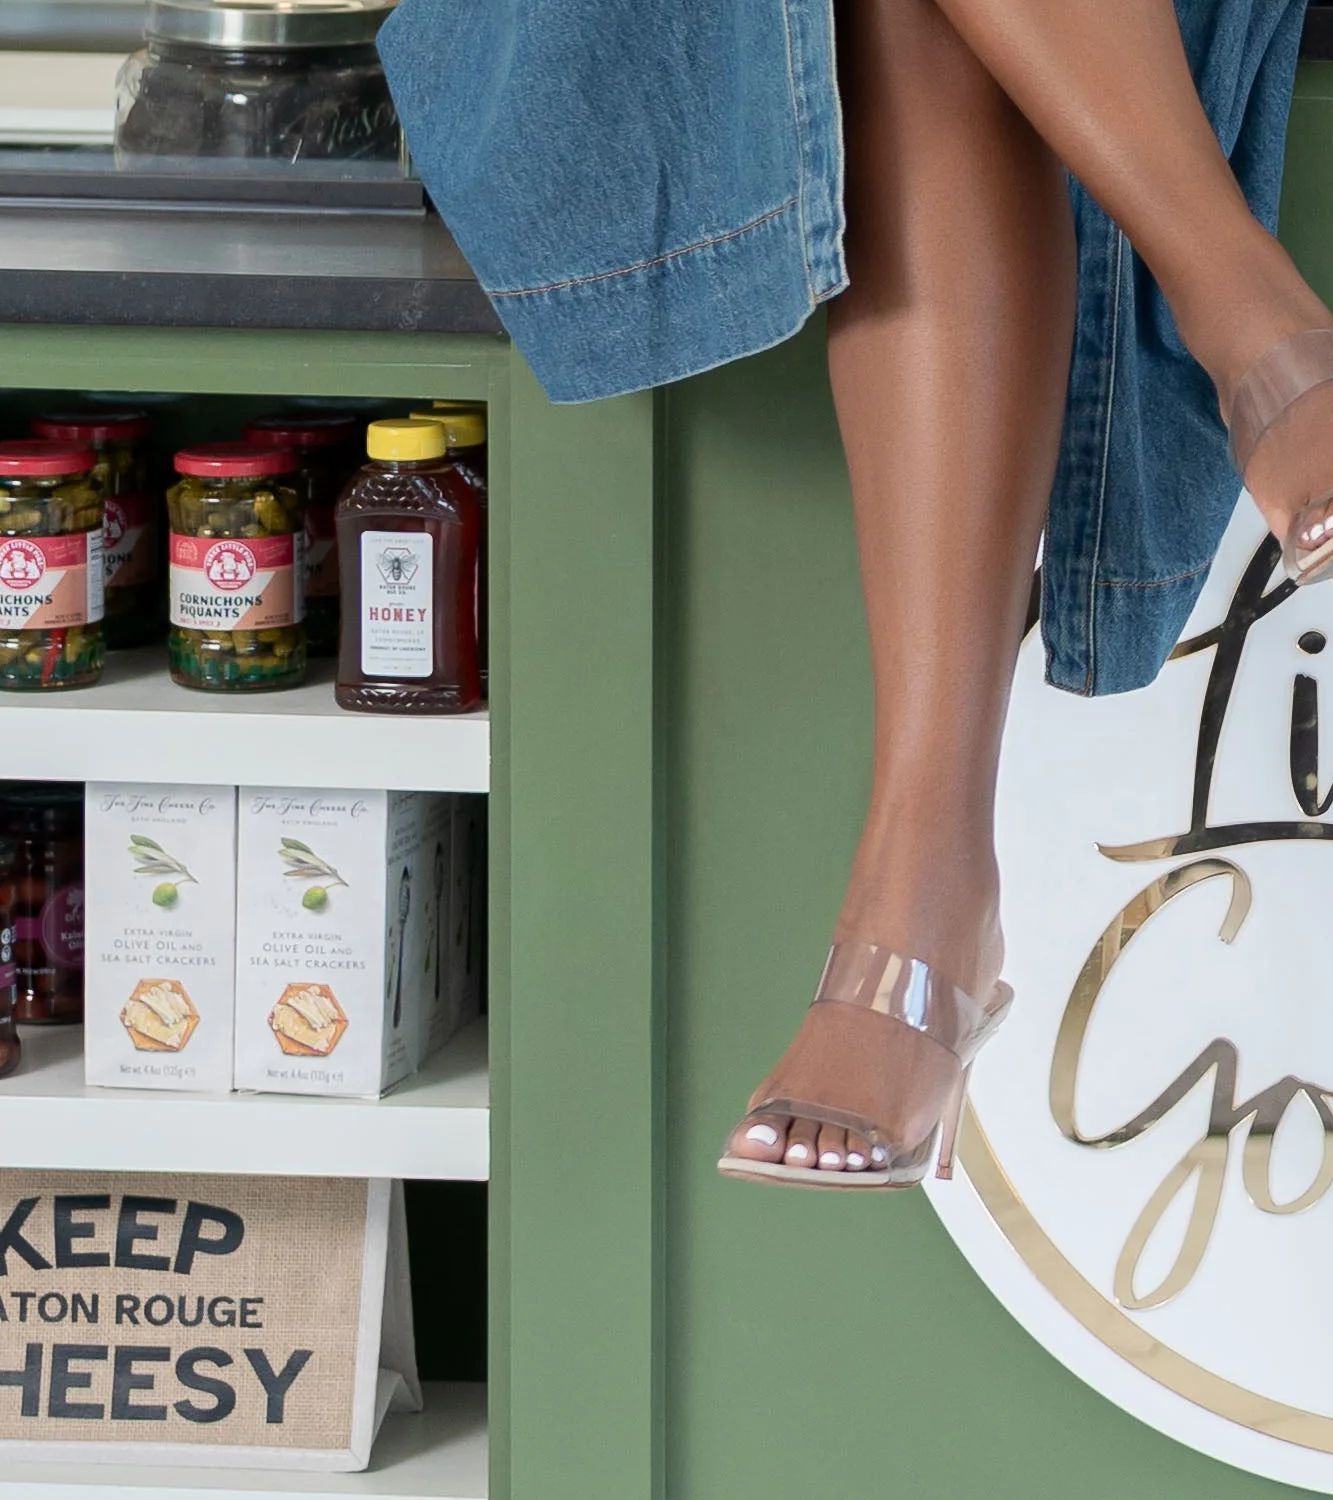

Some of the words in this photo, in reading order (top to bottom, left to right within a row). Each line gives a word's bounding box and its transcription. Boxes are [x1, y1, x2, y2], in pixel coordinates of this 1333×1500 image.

[180, 593, 263, 607] CORNICHONS
[180, 604, 240, 618] PIQUANTS
[369, 606, 428, 623] HONEY
[124, 928, 154, 936] EXTRA
[159, 929, 193, 938] VIRGIN
[272, 931, 304, 940] EXTRA
[307, 932, 343, 941] VIRGIN
[113, 939, 149, 950] OLIVE
[156, 940, 177, 951] OIL
[181, 943, 204, 952] AND
[262, 942, 300, 954] OLIVE
[304, 944, 326, 955] OIL
[330, 947, 353, 956] AND
[100, 953, 121, 963] SEA
[125, 954, 152, 964] SALT
[156, 955, 217, 967] CRACKERS
[250, 956, 270, 966] SEA
[273, 958, 300, 968] SALT
[305, 959, 367, 970] CRACKERS
[0, 1194, 245, 1275] KEEP
[115, 1294, 264, 1329] ROUGE
